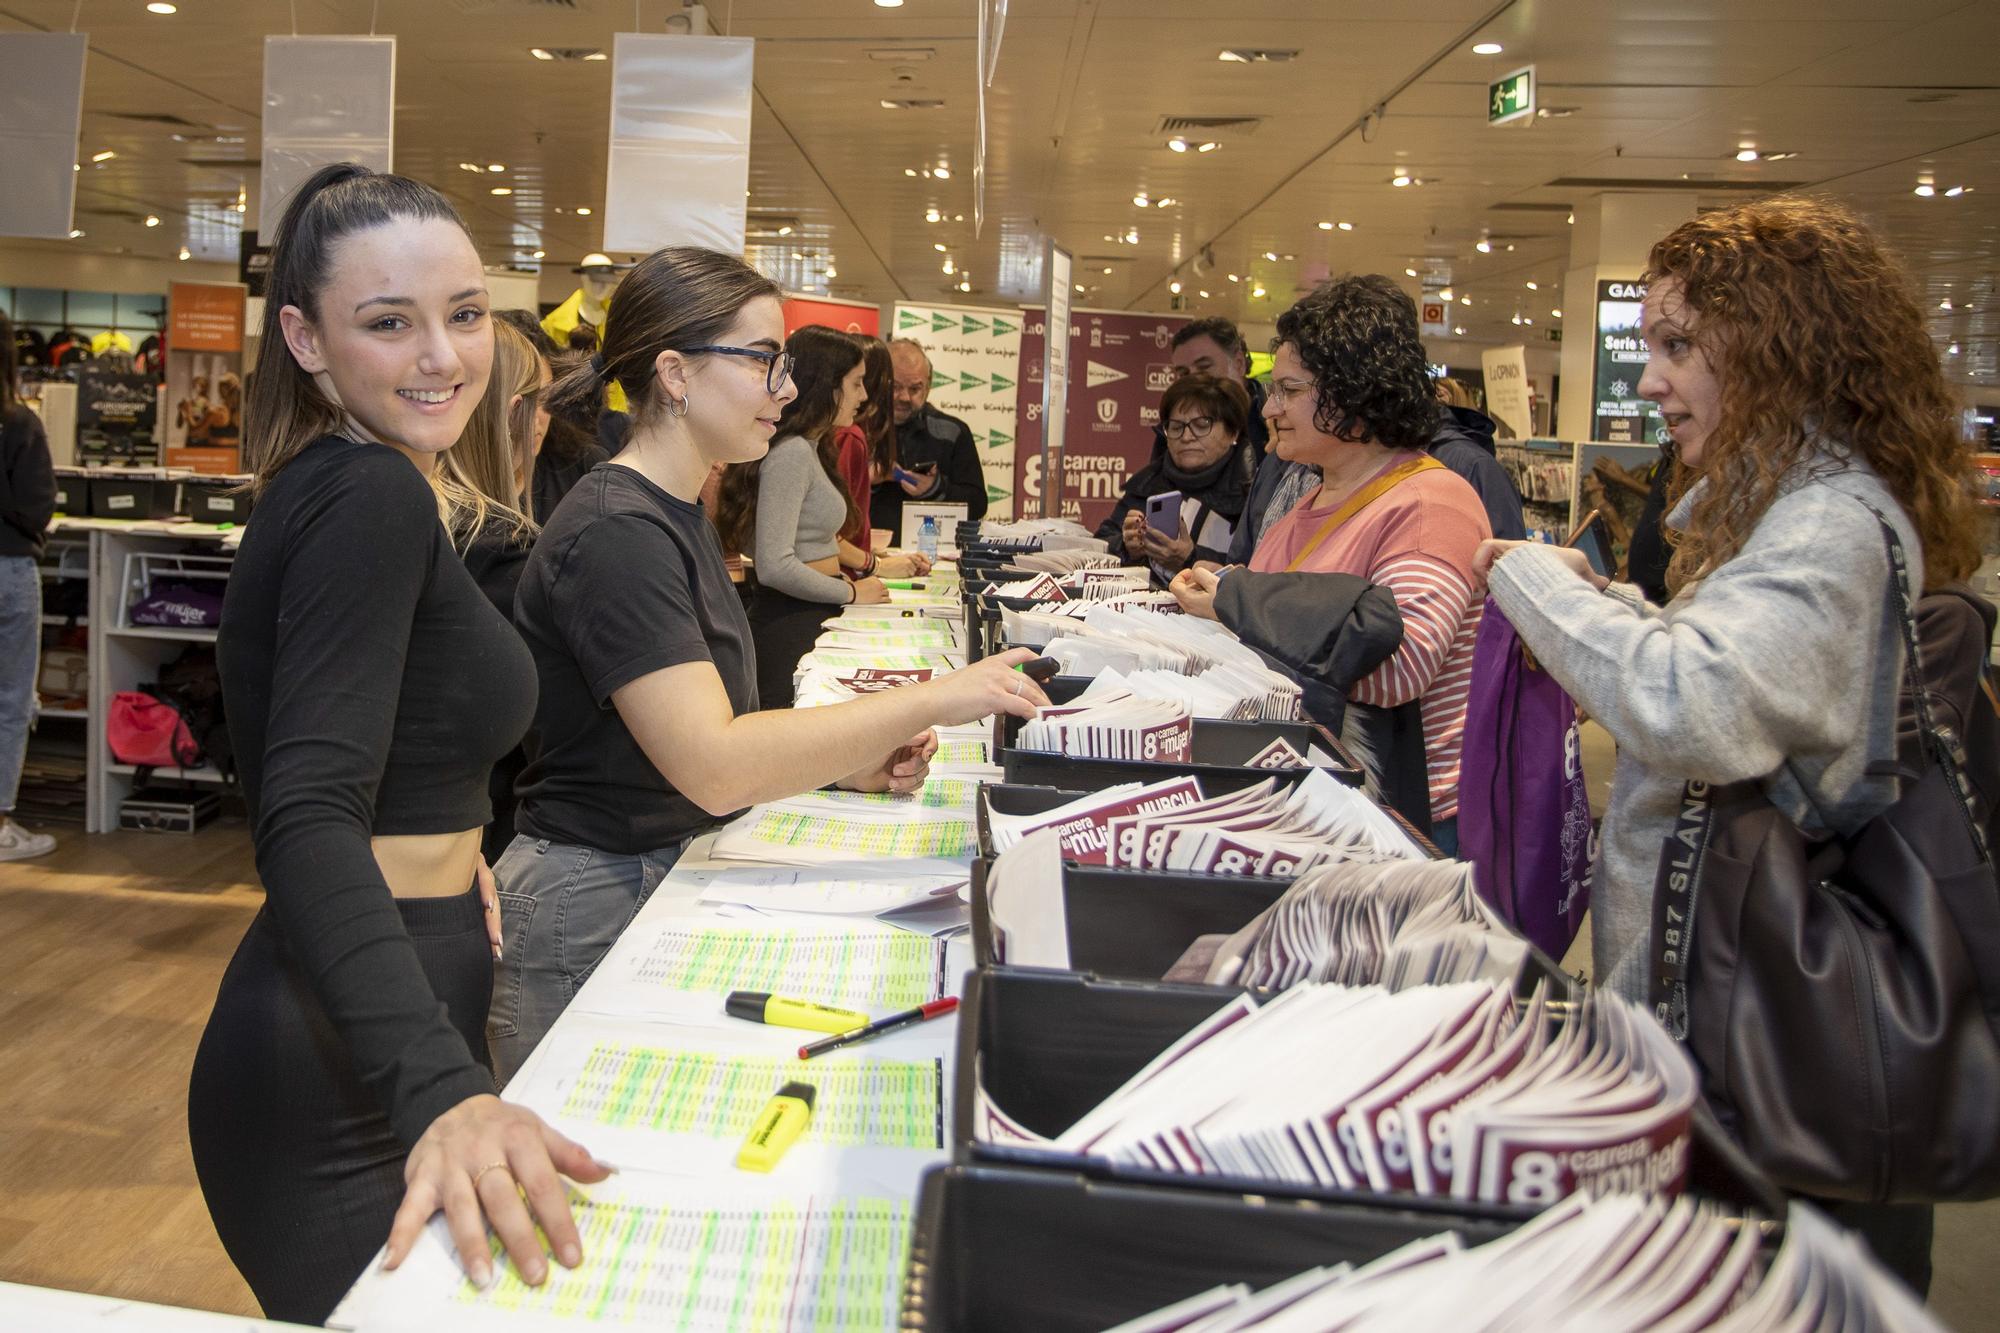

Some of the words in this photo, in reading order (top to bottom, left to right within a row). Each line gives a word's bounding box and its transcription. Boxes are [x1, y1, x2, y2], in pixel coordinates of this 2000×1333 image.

[1608, 283, 1648, 299] GAR
[1063, 455, 1126, 471] carrera
[1158, 725, 1179, 740] carrera
[1164, 730, 1189, 763] mujer
[1058, 816, 1094, 836] arrera
[1668, 778, 1710, 894] SLANG
[1569, 1136, 1650, 1172] carrera
